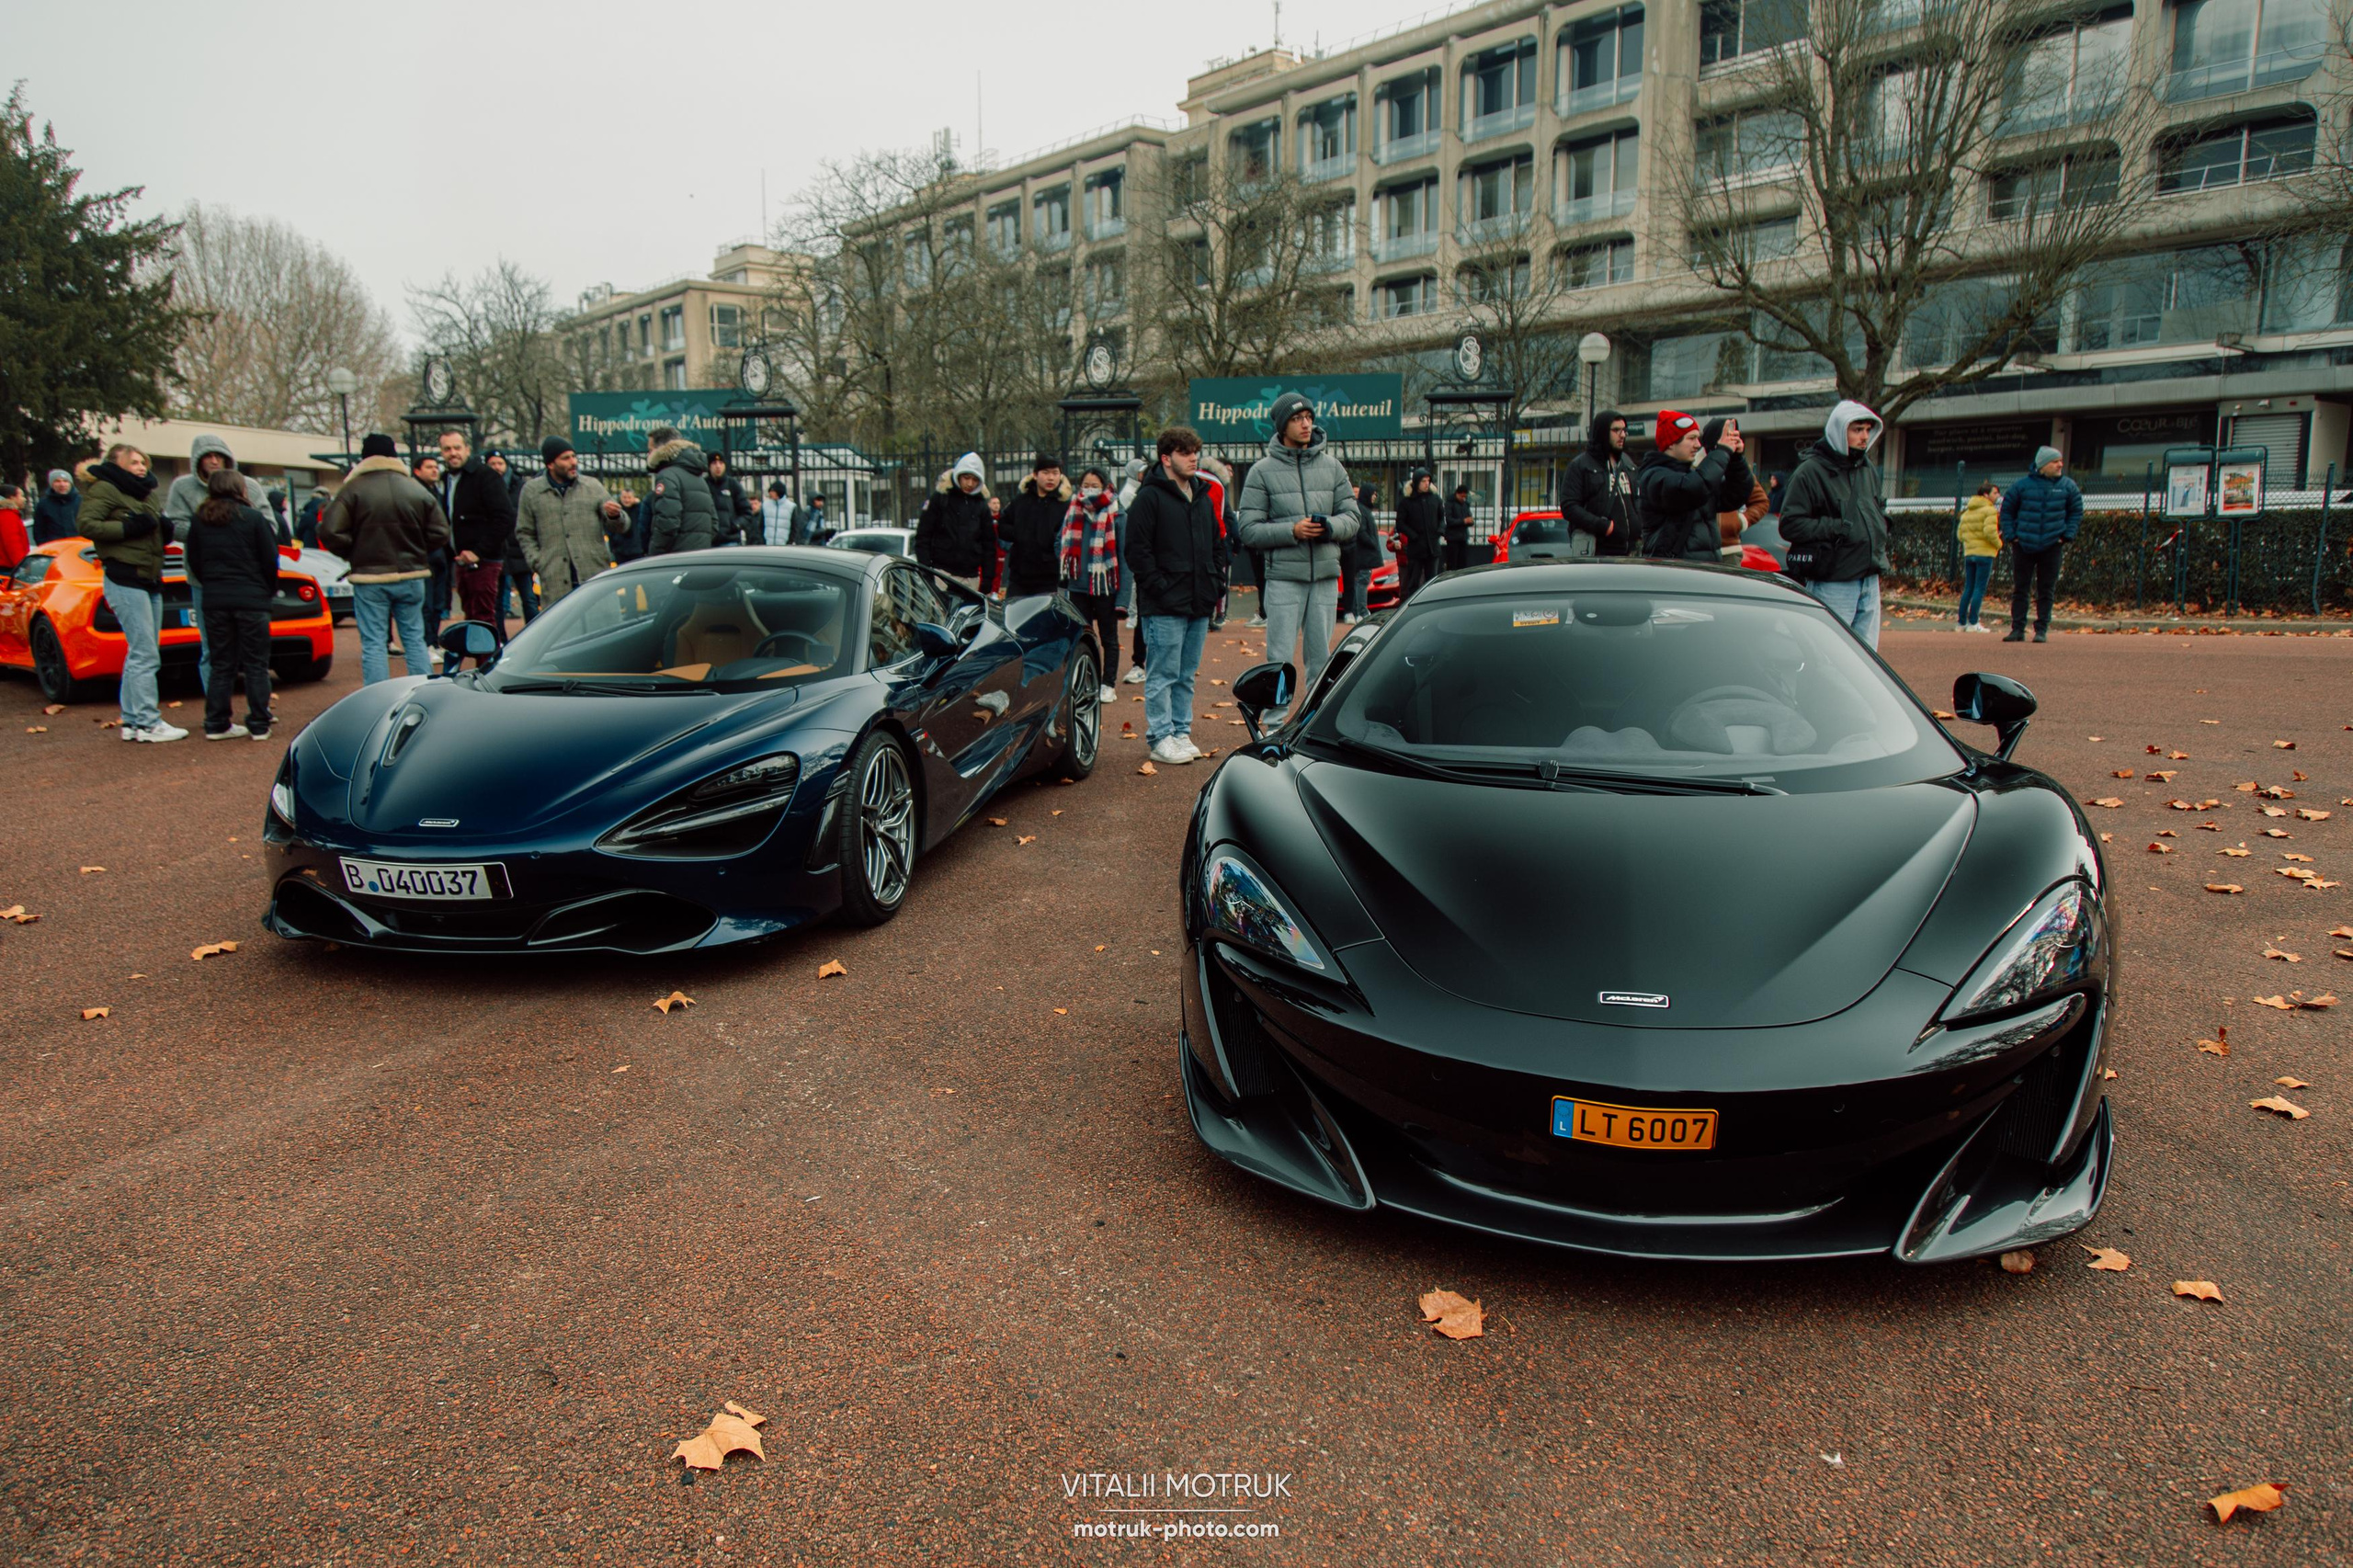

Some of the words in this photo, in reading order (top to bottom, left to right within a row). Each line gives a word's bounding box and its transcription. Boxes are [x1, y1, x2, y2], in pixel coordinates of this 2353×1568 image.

[1199, 402, 1272, 424] Hippodr
[1314, 399, 1392, 417] d'Auteuil
[578, 415, 674, 437] Hippodrome
[346, 864, 365, 889] B
[377, 869, 478, 895] 040037
[1606, 994, 1665, 1004] McLaren
[1559, 1120, 1567, 1131] L
[1580, 1109, 1618, 1139] LT
[1629, 1117, 1709, 1143] 6007
